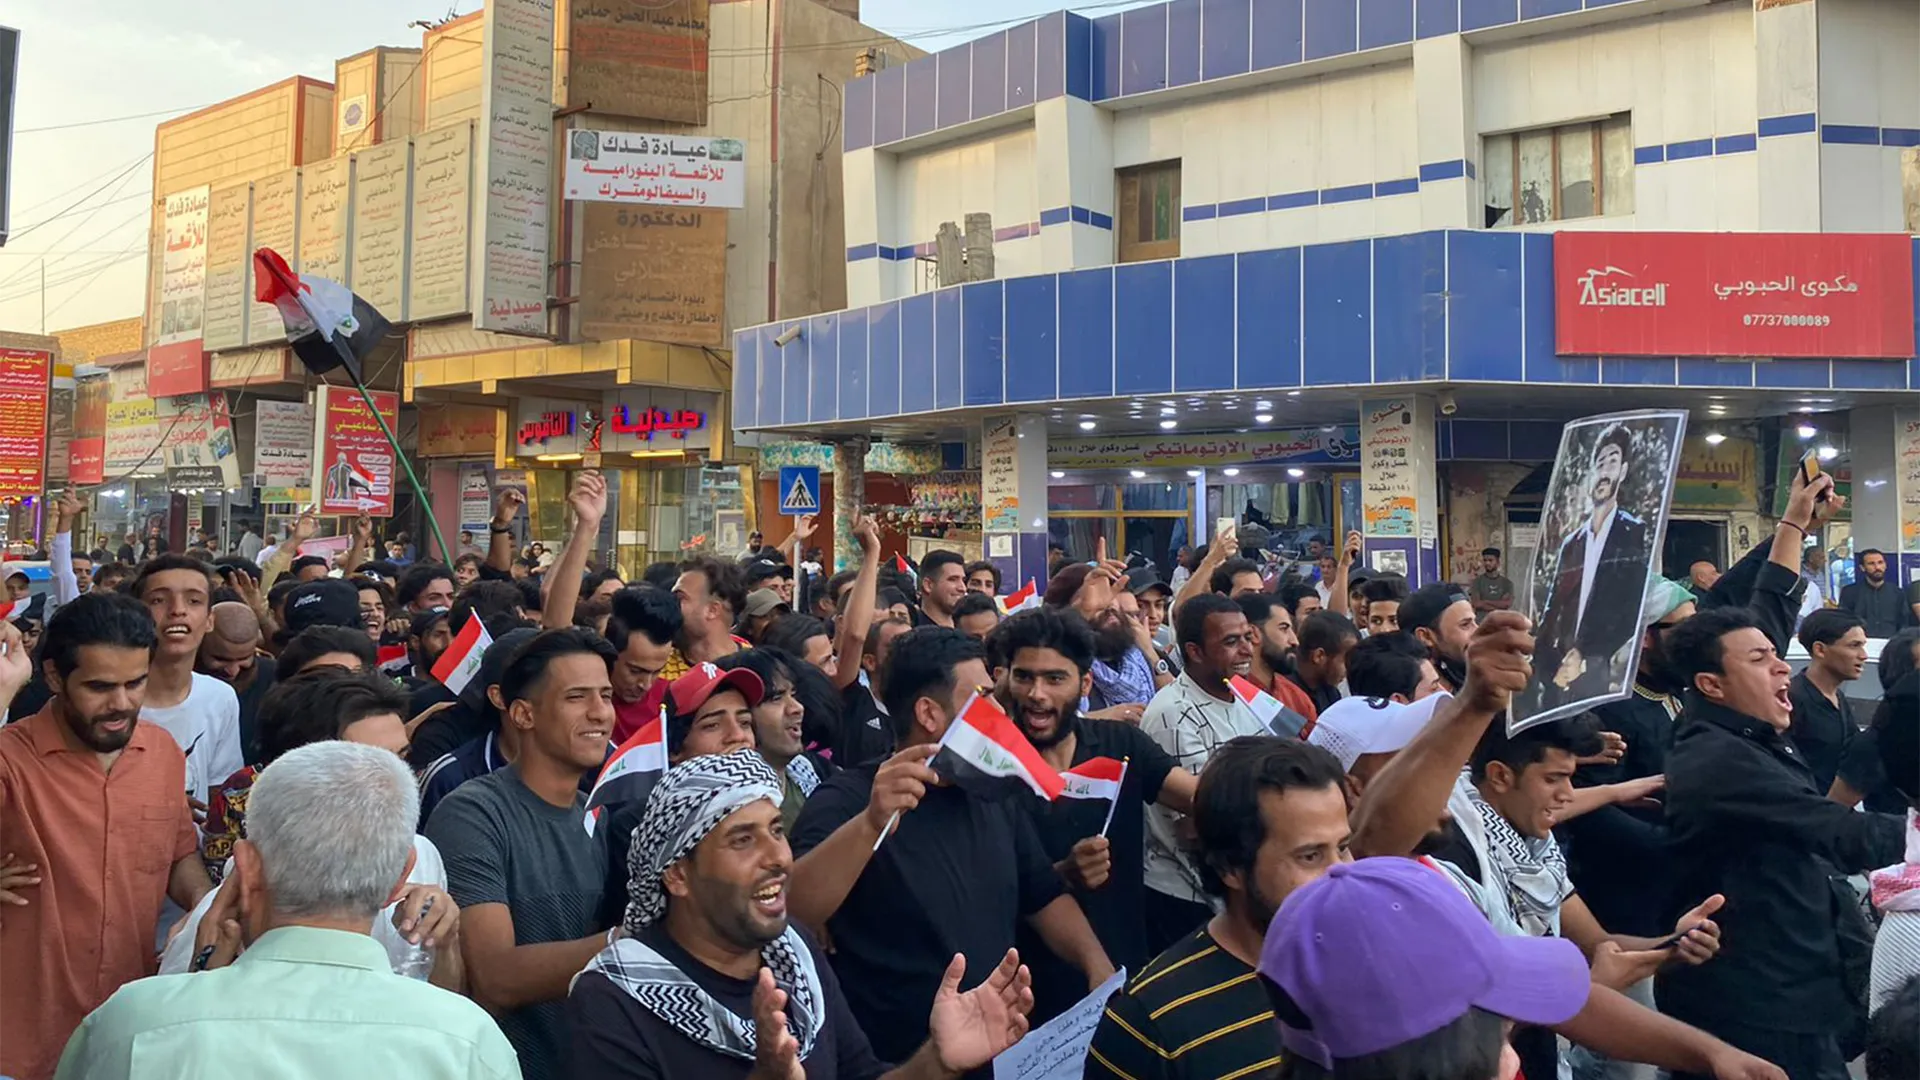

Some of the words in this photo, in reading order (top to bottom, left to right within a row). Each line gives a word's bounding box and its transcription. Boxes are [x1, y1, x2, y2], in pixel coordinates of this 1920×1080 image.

[652, 15, 673, 32] عبد
[677, 19, 705, 30] محمد
[602, 136, 648, 154] فدك
[652, 136, 707, 162] عيادة
[583, 159, 665, 180] البنورامية
[669, 163, 724, 181] للأشعة
[617, 210, 701, 228] الدكتورة
[1577, 276, 1666, 306] Asiacell
[1714, 276, 1795, 300] الحبوبي
[1801, 275, 1858, 297] مكوى
[488, 298, 543, 321] صيدلية
[1743, 314, 1830, 327] 07737000089
[611, 405, 701, 440] صيدلية
[1371, 403, 1405, 423] مكوى
[517, 411, 569, 445] الناقوس
[1252, 439, 1320, 459] الحبوبي
[1391, 460, 1408, 468] غسل
[1379, 472, 1397, 480] خلال
[1368, 483, 1391, 492] دقيقة
